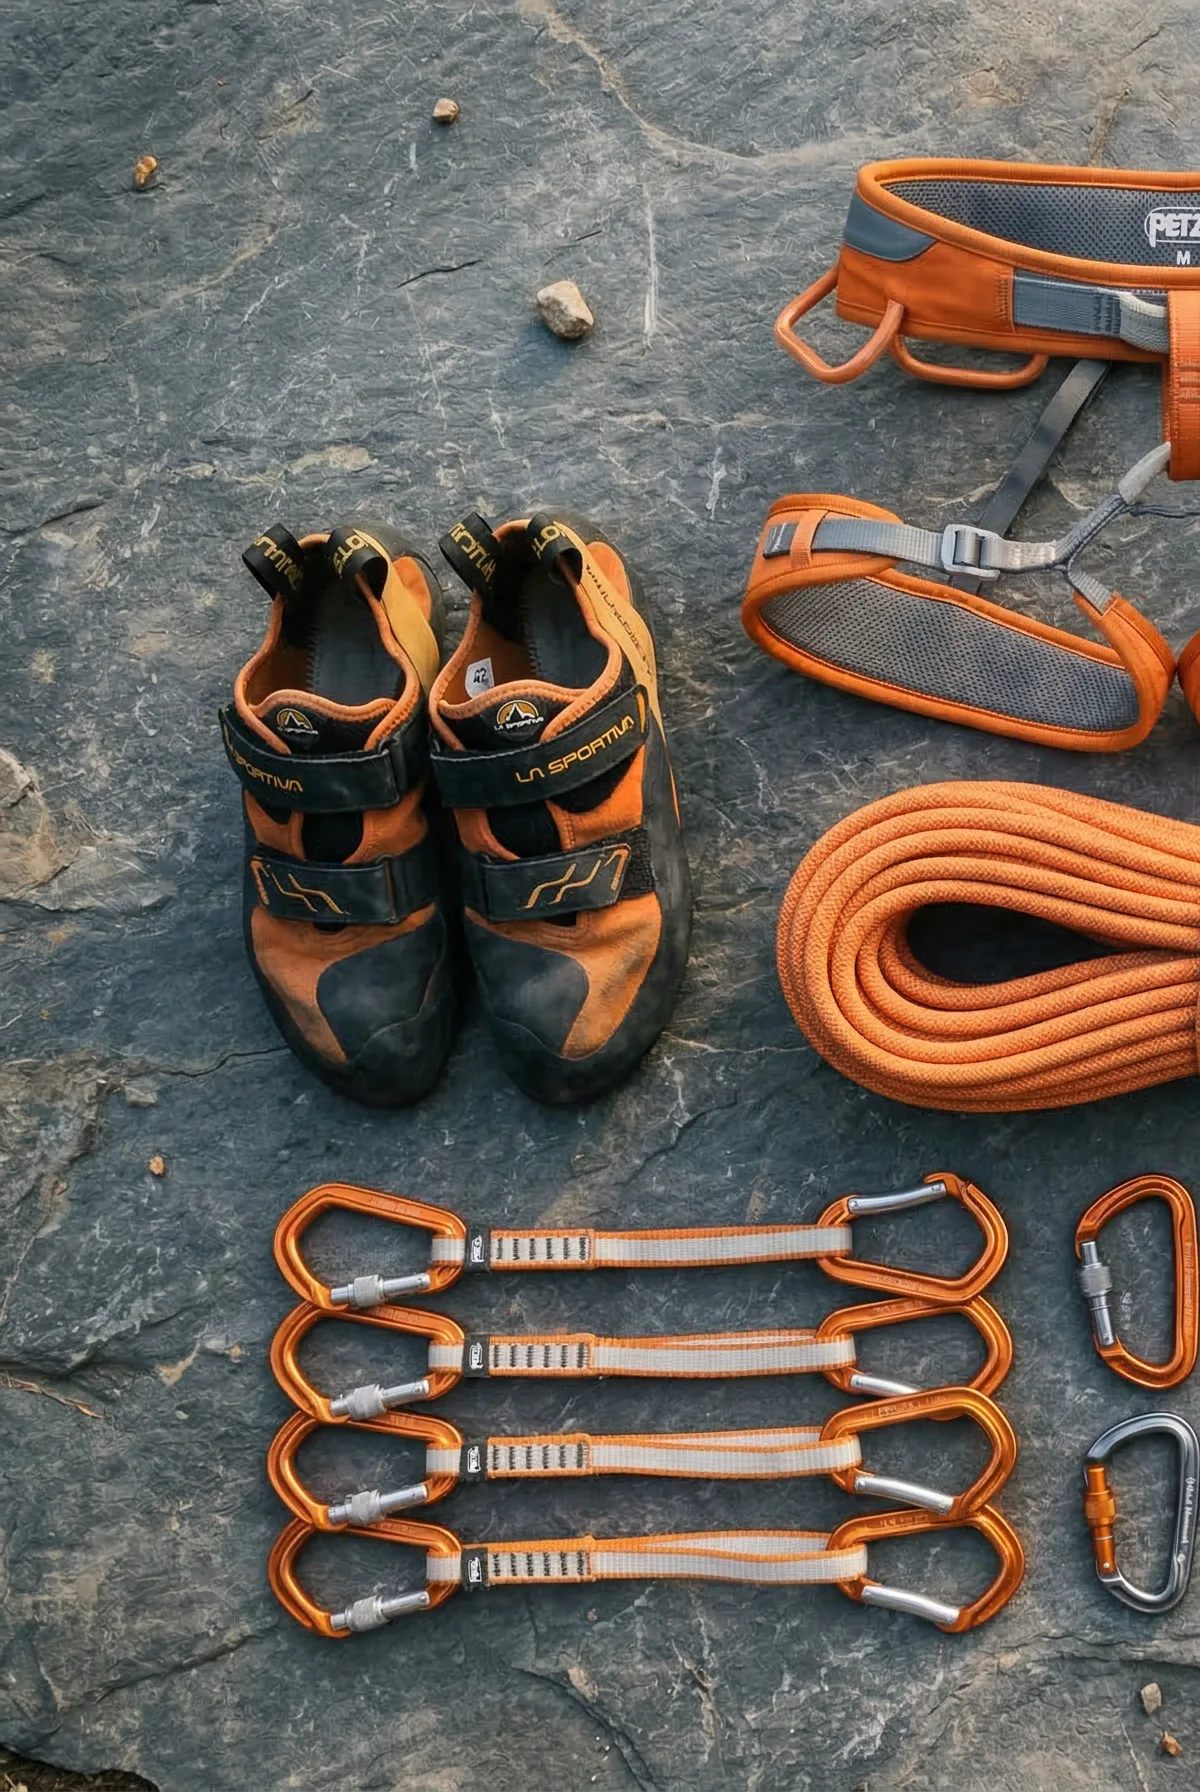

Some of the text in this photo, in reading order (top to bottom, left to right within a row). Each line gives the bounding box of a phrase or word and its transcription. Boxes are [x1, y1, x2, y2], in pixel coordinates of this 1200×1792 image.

[1176, 250, 1191, 265] M
[515, 715, 635, 783] LA SPORTIVA
